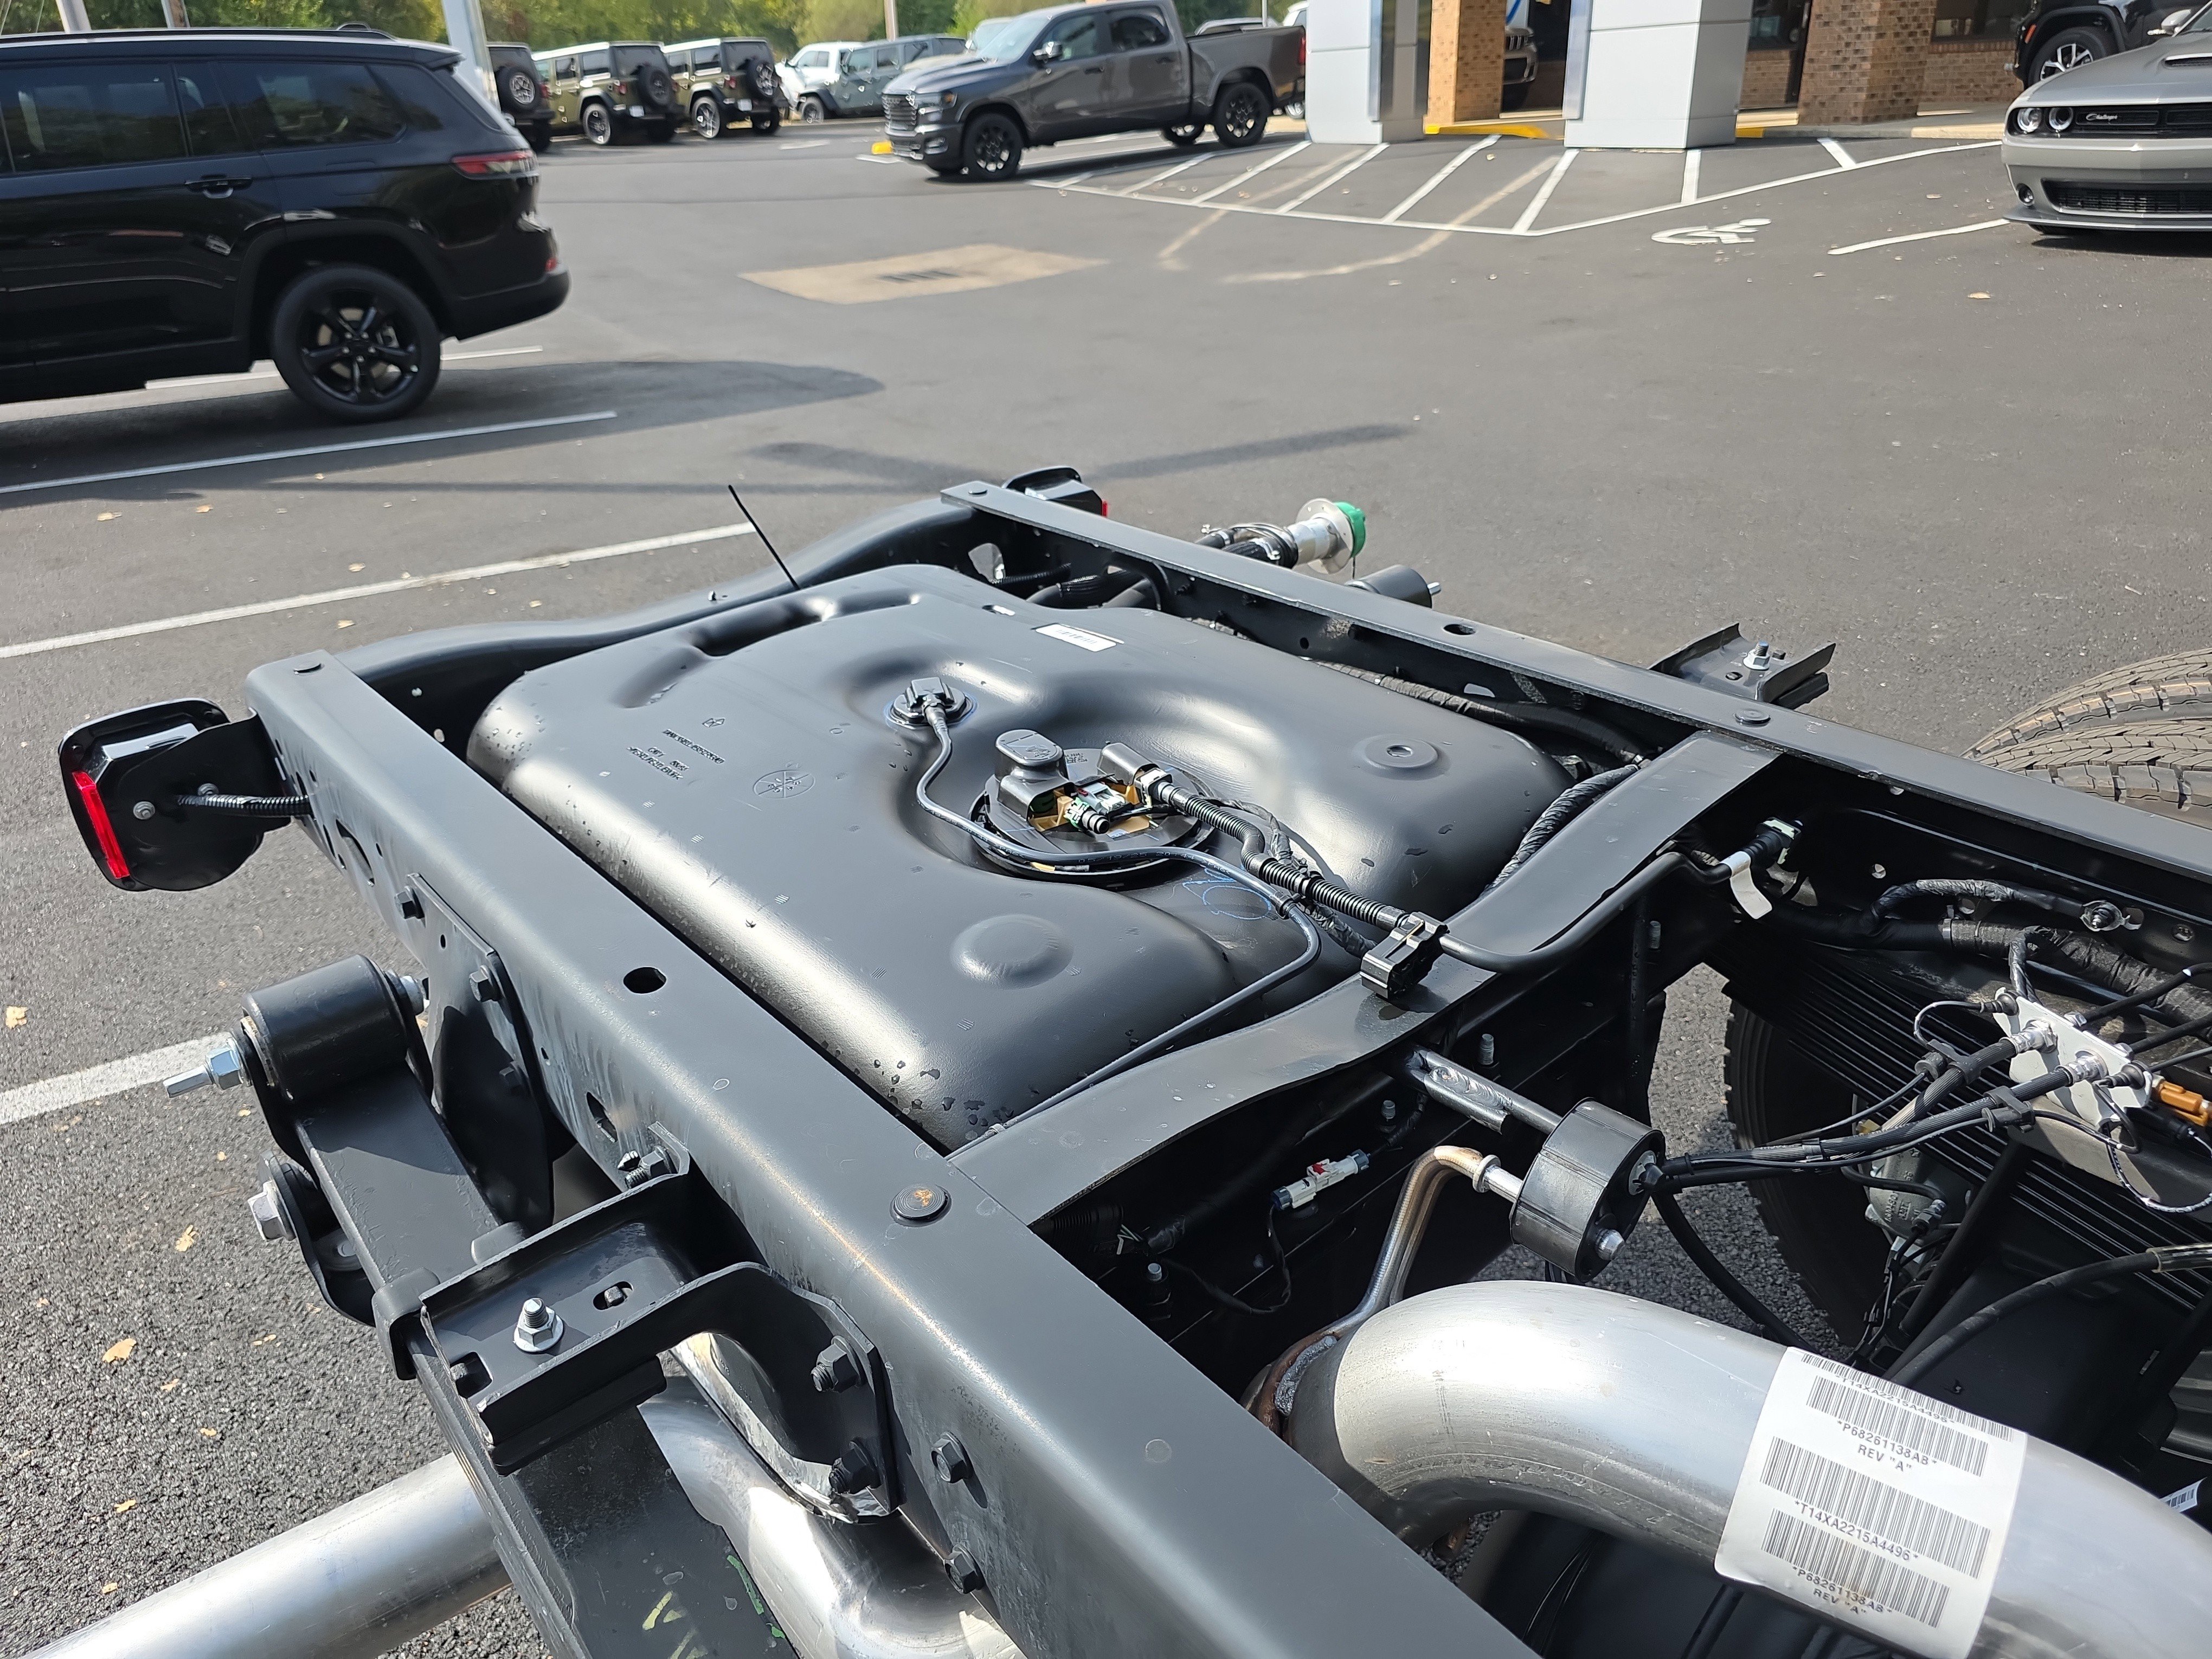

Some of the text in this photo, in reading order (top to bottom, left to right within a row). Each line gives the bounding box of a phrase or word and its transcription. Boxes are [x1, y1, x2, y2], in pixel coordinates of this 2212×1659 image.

[1857, 1444, 1912, 1472] REV "A"
[1813, 1587, 1867, 1615] REV "A"
